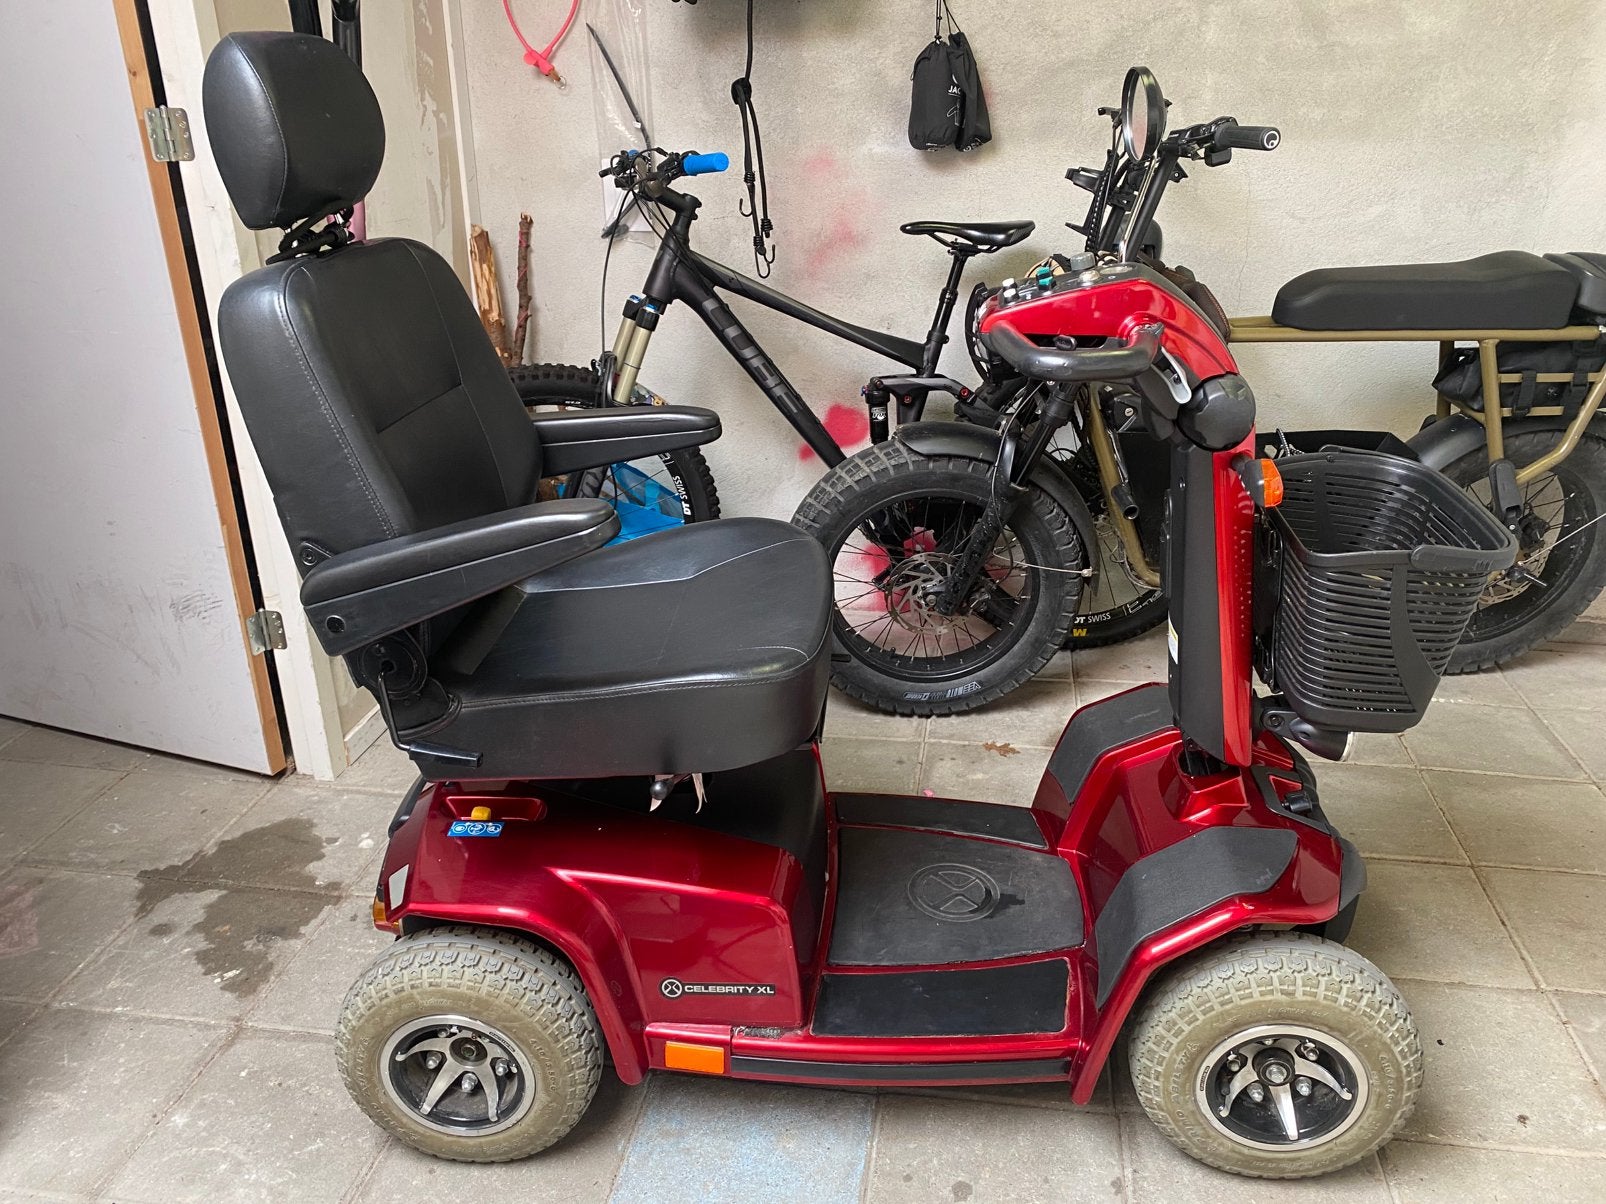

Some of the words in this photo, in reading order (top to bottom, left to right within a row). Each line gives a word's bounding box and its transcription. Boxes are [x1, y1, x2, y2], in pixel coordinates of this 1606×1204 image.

[673, 475, 688, 500] SWISS
[682, 501, 692, 516] DT
[1087, 612, 1111, 623] SWISS
[684, 985, 754, 994] CELEBRITY
[756, 986, 775, 994] XL
